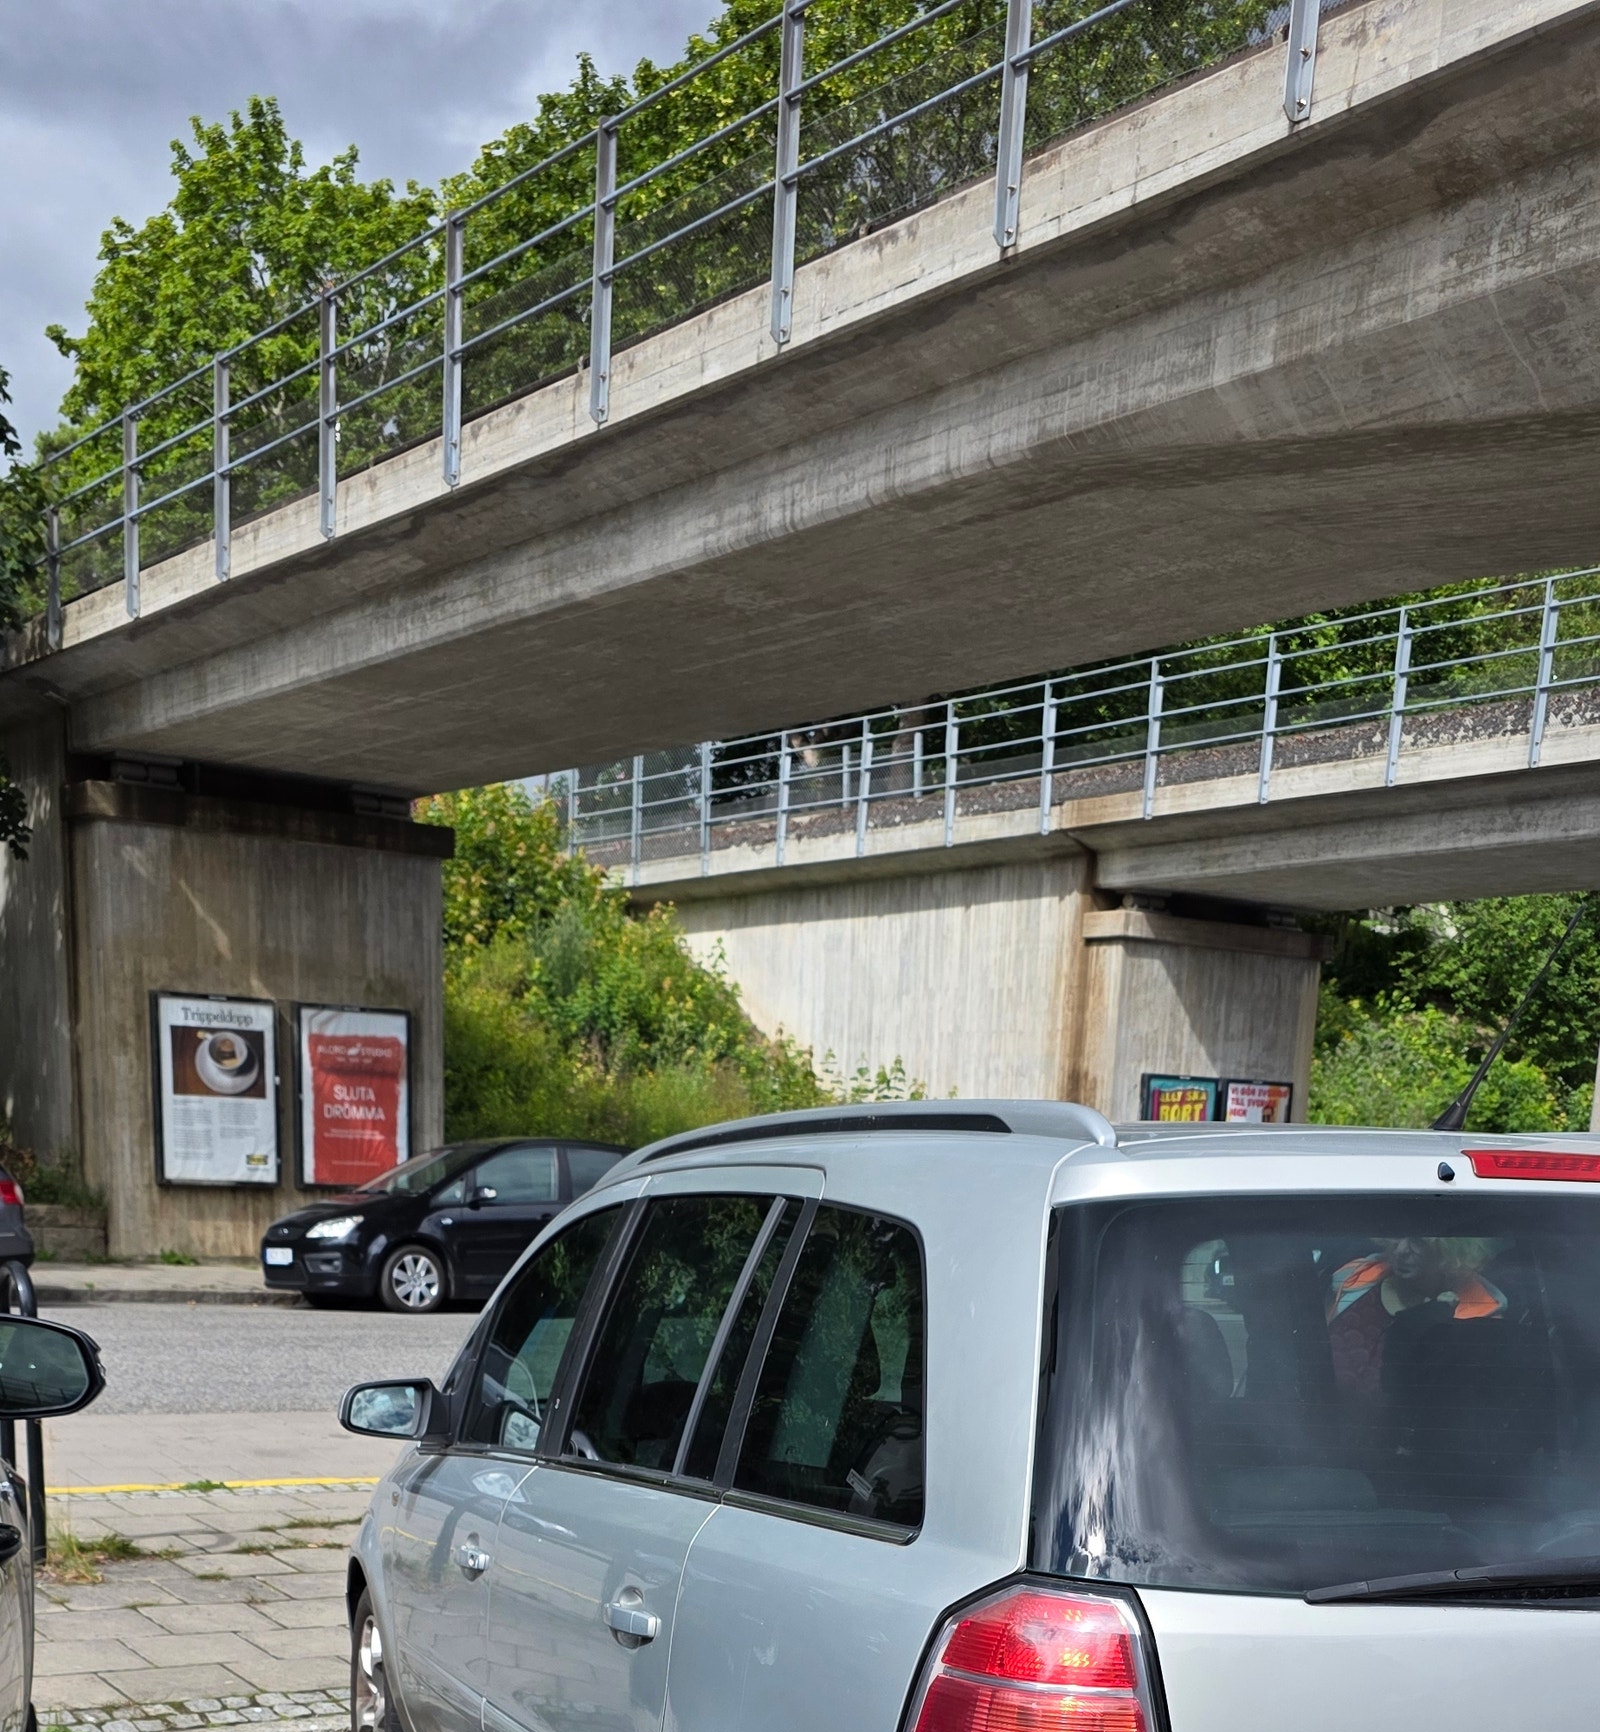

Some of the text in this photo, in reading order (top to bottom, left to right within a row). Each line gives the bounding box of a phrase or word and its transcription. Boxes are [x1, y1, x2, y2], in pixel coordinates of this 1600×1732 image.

[332, 1084, 377, 1102] SLUTA
[323, 1102, 387, 1121] DRÖMMA
[1159, 1103, 1204, 1121] BORT
